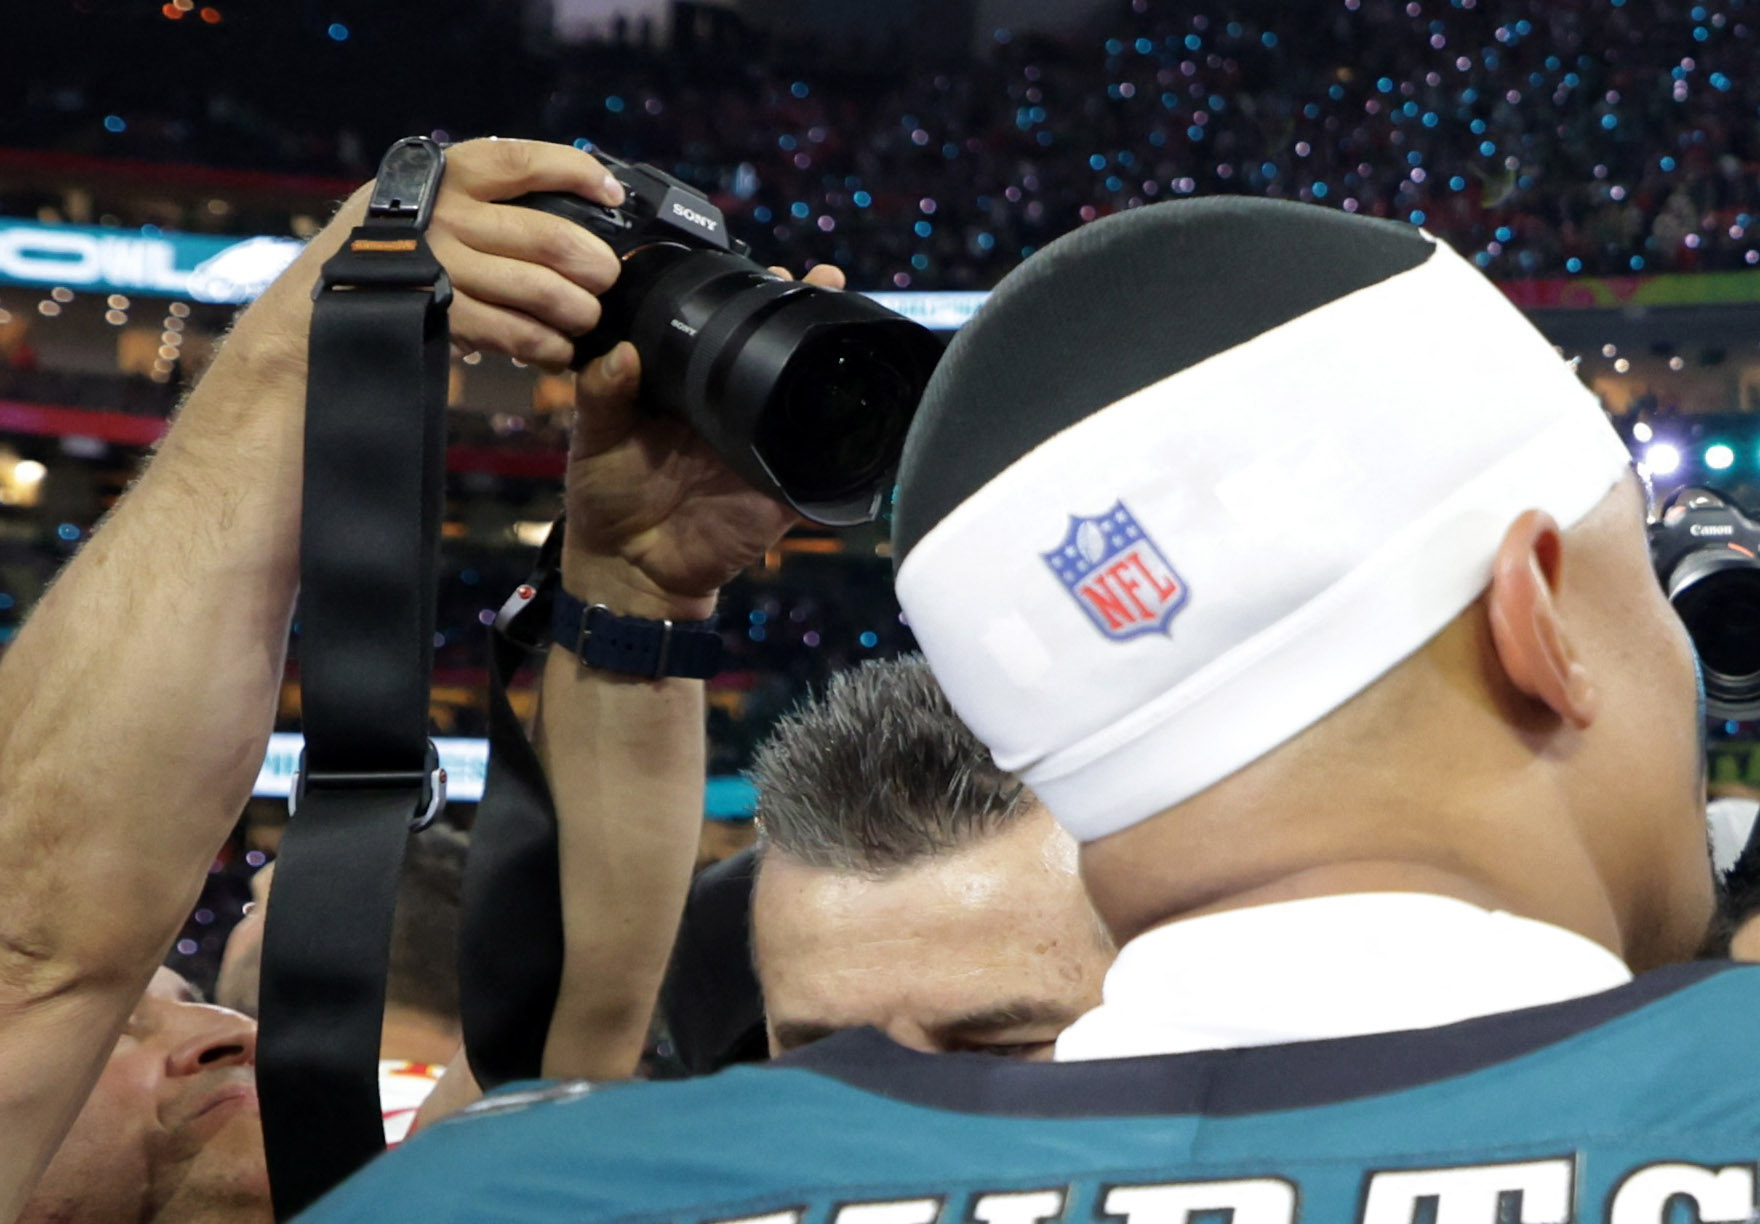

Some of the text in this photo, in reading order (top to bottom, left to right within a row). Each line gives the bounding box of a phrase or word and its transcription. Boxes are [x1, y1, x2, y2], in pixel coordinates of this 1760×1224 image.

[672, 203, 718, 231] SONY
[670, 318, 698, 336] SONY
[1690, 524, 1734, 537] Canon
[1079, 551, 1178, 630] NFL
